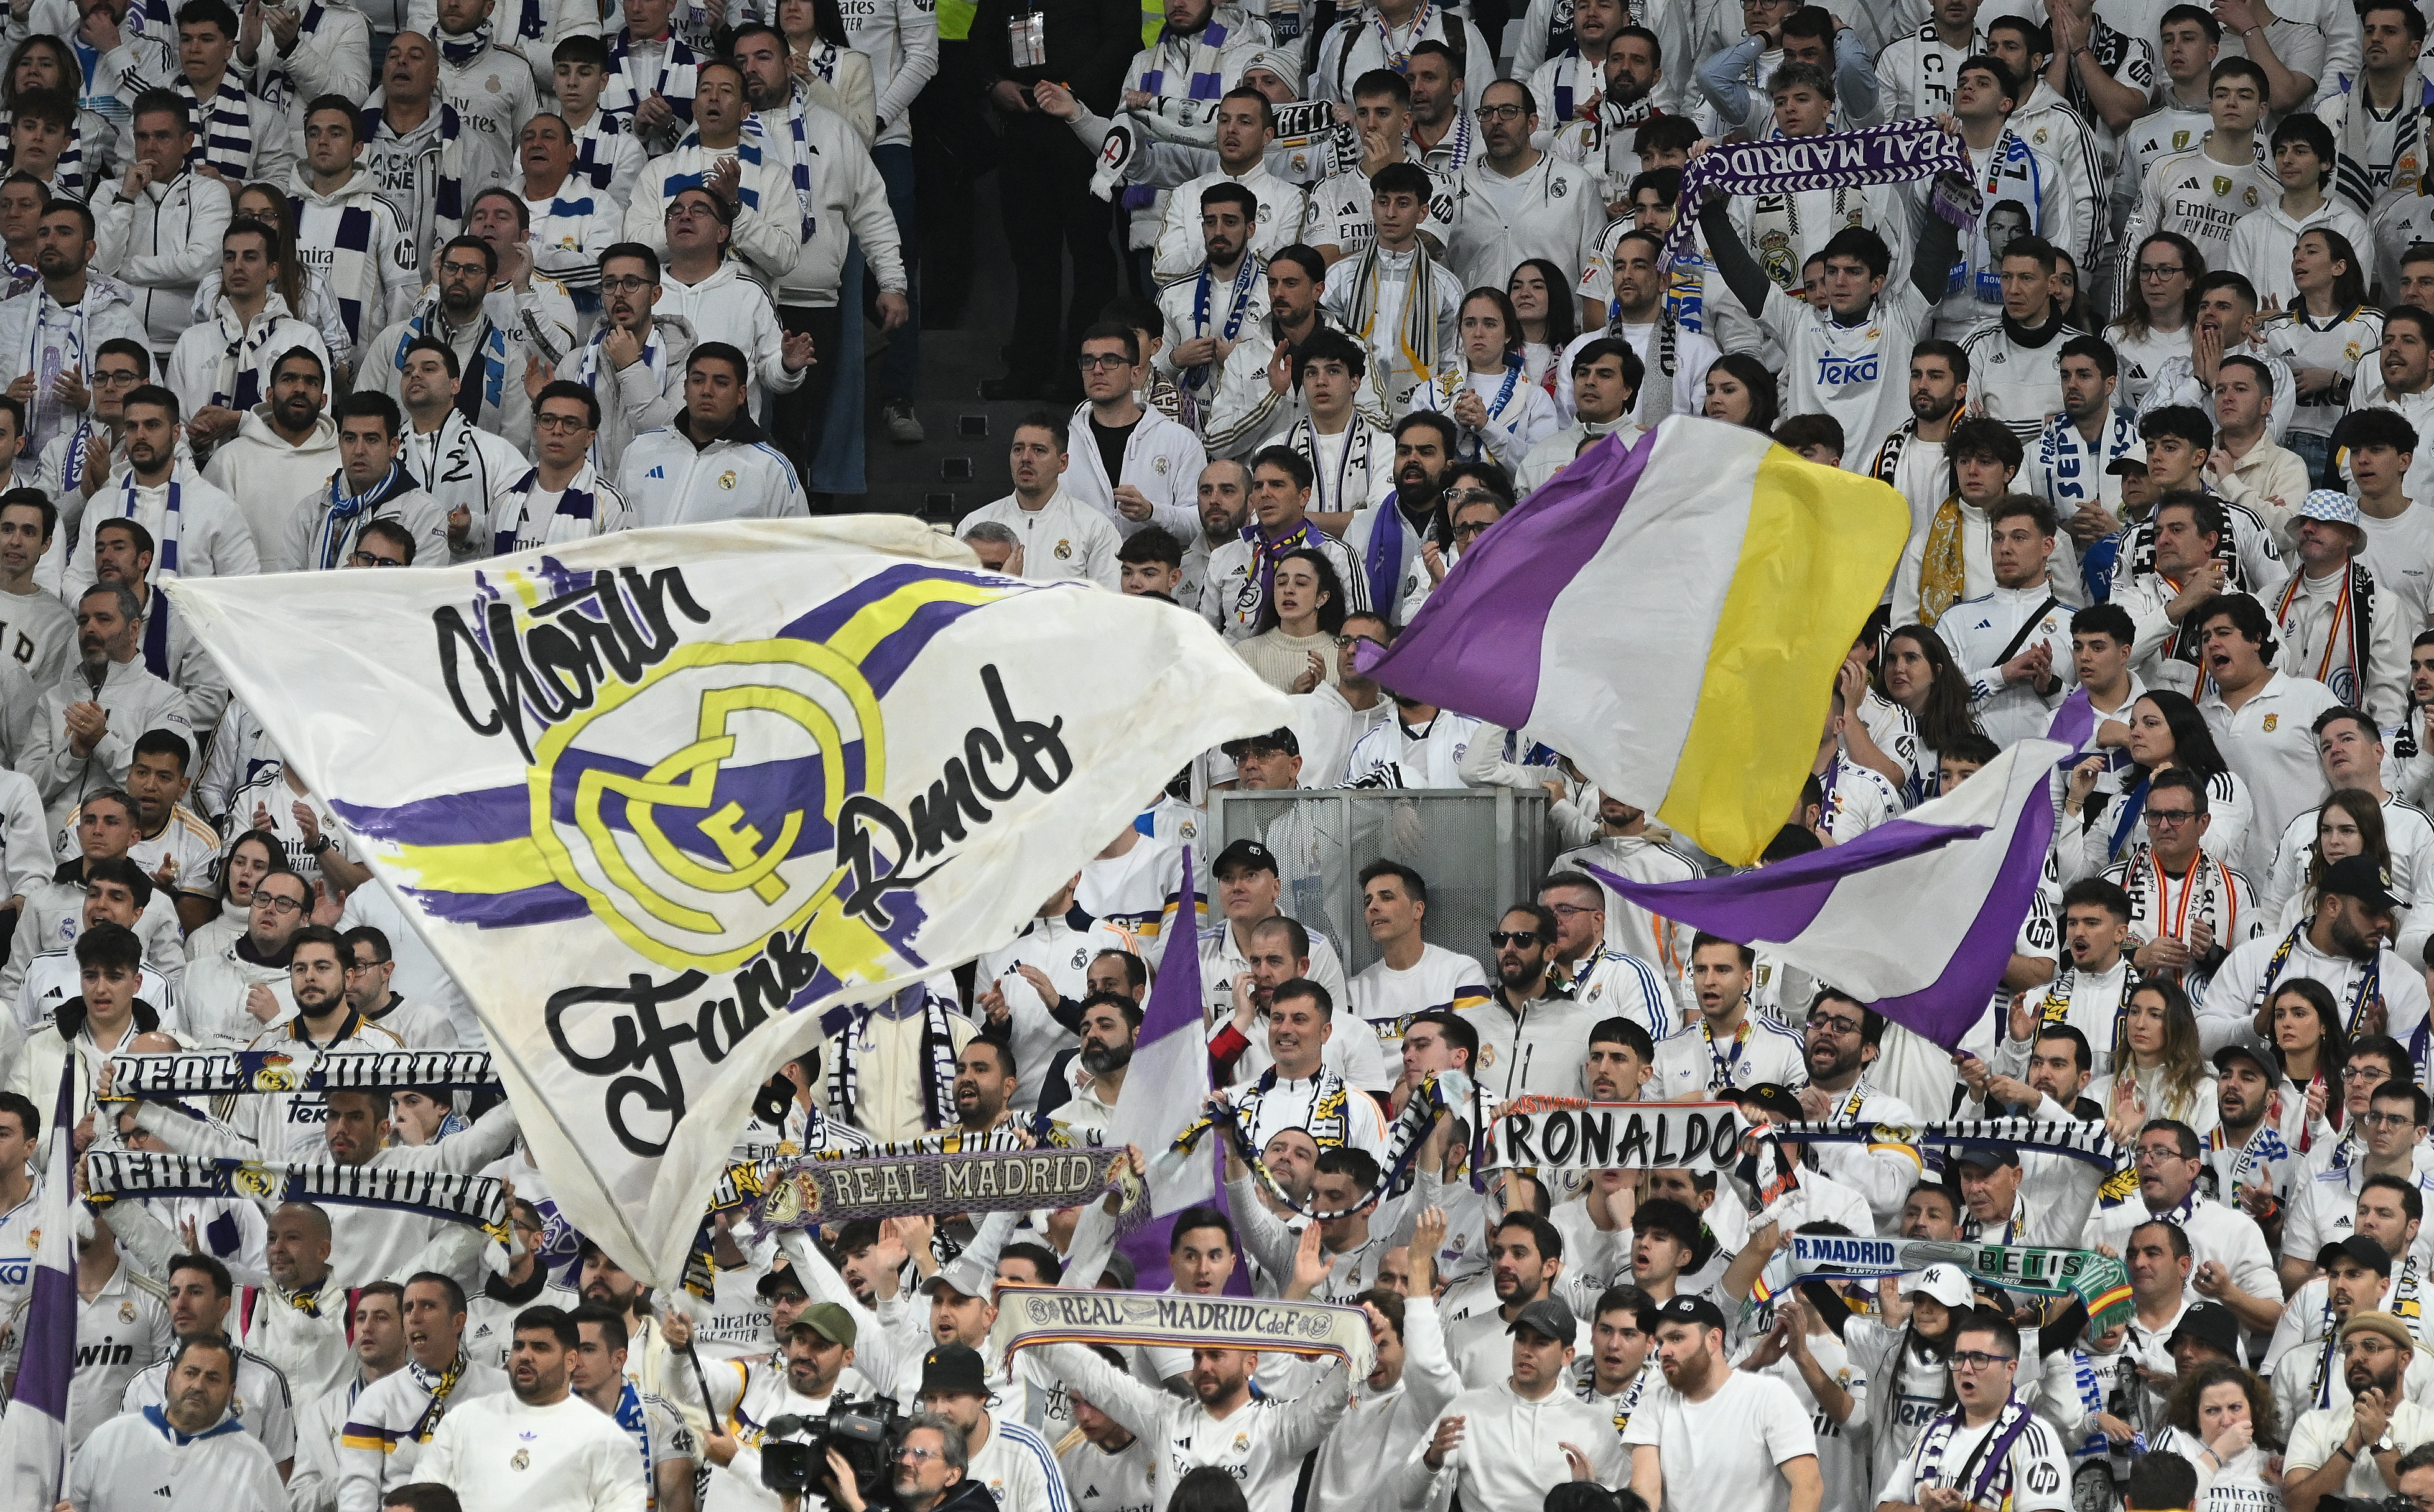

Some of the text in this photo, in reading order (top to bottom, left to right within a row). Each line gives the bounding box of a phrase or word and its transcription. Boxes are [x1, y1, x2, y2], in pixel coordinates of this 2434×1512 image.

[1731, 136, 1869, 175] MADRID
[1432, 194, 1452, 223] hp
[2176, 200, 2242, 226] Emirat
[2183, 220, 2232, 241] FLY BETTE
[397, 239, 417, 271] hp
[2028, 919, 2053, 950] hp
[213, 1033, 236, 1042] TOMMY
[110, 1051, 499, 1093] REAL MADRI
[287, 1093, 328, 1124] Tek
[1505, 1111, 1739, 1167] RONALDO
[827, 1153, 1095, 1208] REAL MADRID
[1794, 1238, 1895, 1265] R.MADRID
[1978, 1250, 2084, 1278] BETIS
[1058, 1297, 1124, 1326] REAL
[1157, 1299, 1255, 1331] MADRID
[76, 1335, 134, 1367] win
[1892, 1394, 1939, 1429] Tek
[2030, 1463, 2058, 1495] hp
[2203, 1485, 2282, 1506] mirates
